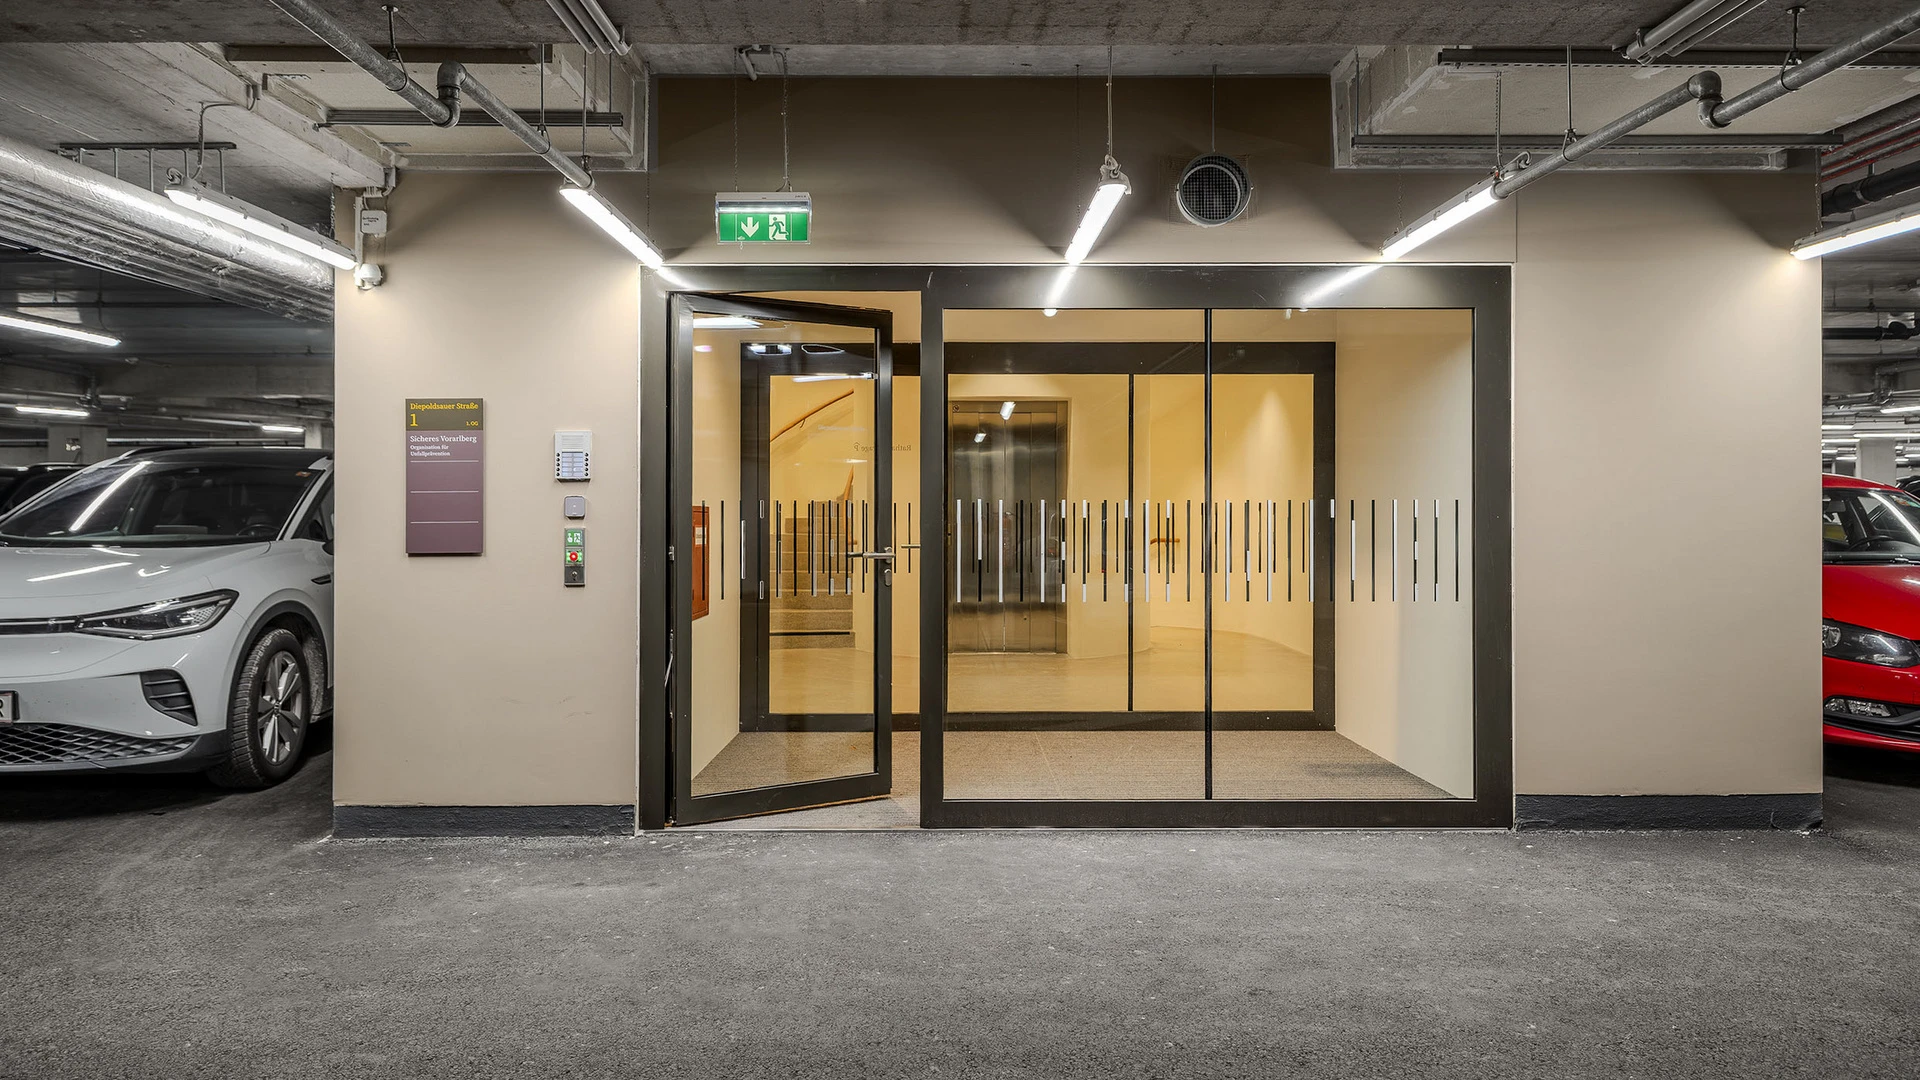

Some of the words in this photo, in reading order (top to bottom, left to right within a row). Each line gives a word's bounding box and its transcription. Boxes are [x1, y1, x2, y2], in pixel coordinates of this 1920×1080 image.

[410, 403, 455, 411] Diepoldsauer
[410, 413, 418, 426] 1
[440, 435, 477, 443] Vorarlberg
